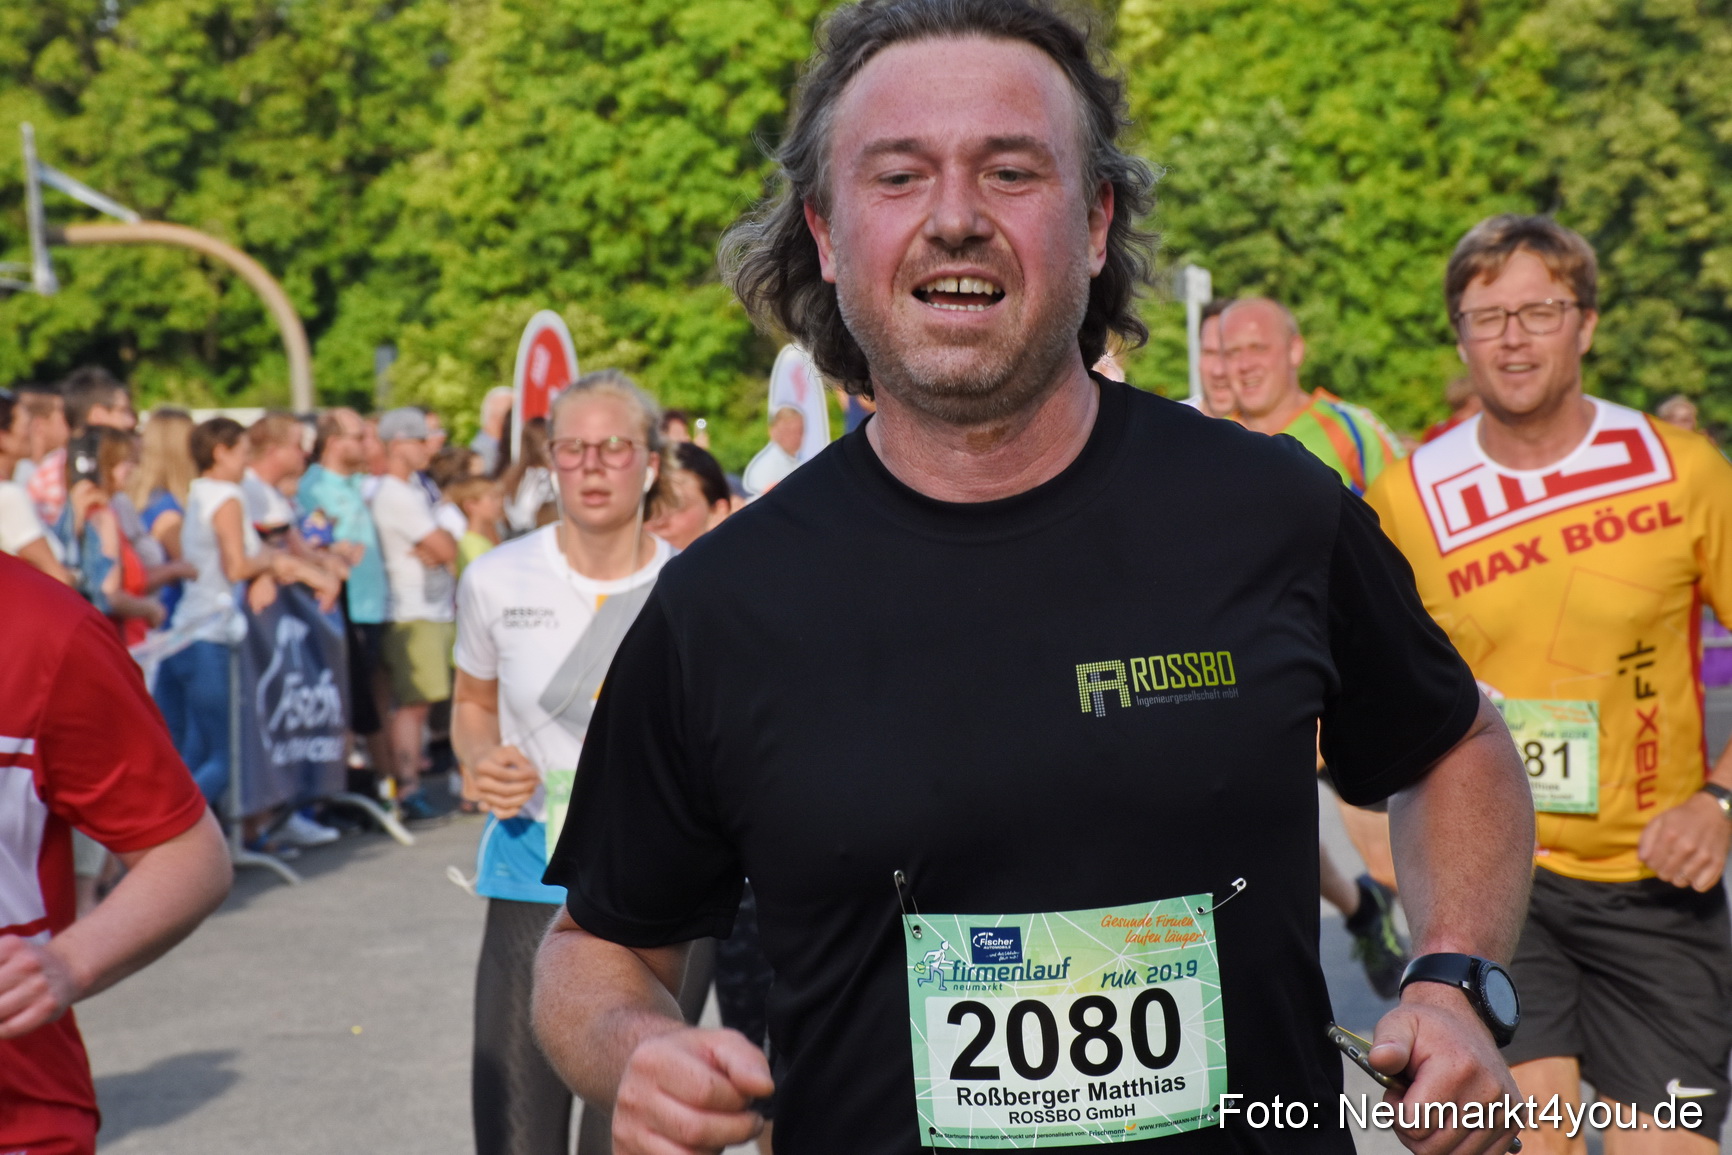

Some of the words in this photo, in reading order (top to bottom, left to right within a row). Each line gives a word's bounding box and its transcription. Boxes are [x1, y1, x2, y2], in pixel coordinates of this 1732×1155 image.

[1447, 536, 1549, 599] MAX
[1560, 501, 1684, 554] BÖGL
[1130, 651, 1236, 693] ROSSBO
[1136, 688, 1221, 707] Ingenieurgesellschaft
[1222, 687, 1239, 699] mbH
[1101, 913, 1152, 928] Gesunde
[1155, 914, 1194, 928] Firmen
[980, 934, 1014, 946] Fischer
[1125, 929, 1161, 946] laufen
[1164, 929, 1206, 949] länger!
[953, 956, 1071, 981] firmenlauf
[1146, 959, 1198, 984] 2019
[953, 983, 1003, 991] neumarkt
[946, 987, 1182, 1081] 2080
[956, 1086, 1080, 1111] Roßberger
[1088, 1076, 1187, 1101] Matthias
[1008, 1108, 1081, 1125] ROSSBO
[1085, 1103, 1136, 1120] GmbH
[1036, 1131, 1073, 1140] personalisiert
[1089, 1128, 1126, 1136] Frischmann
